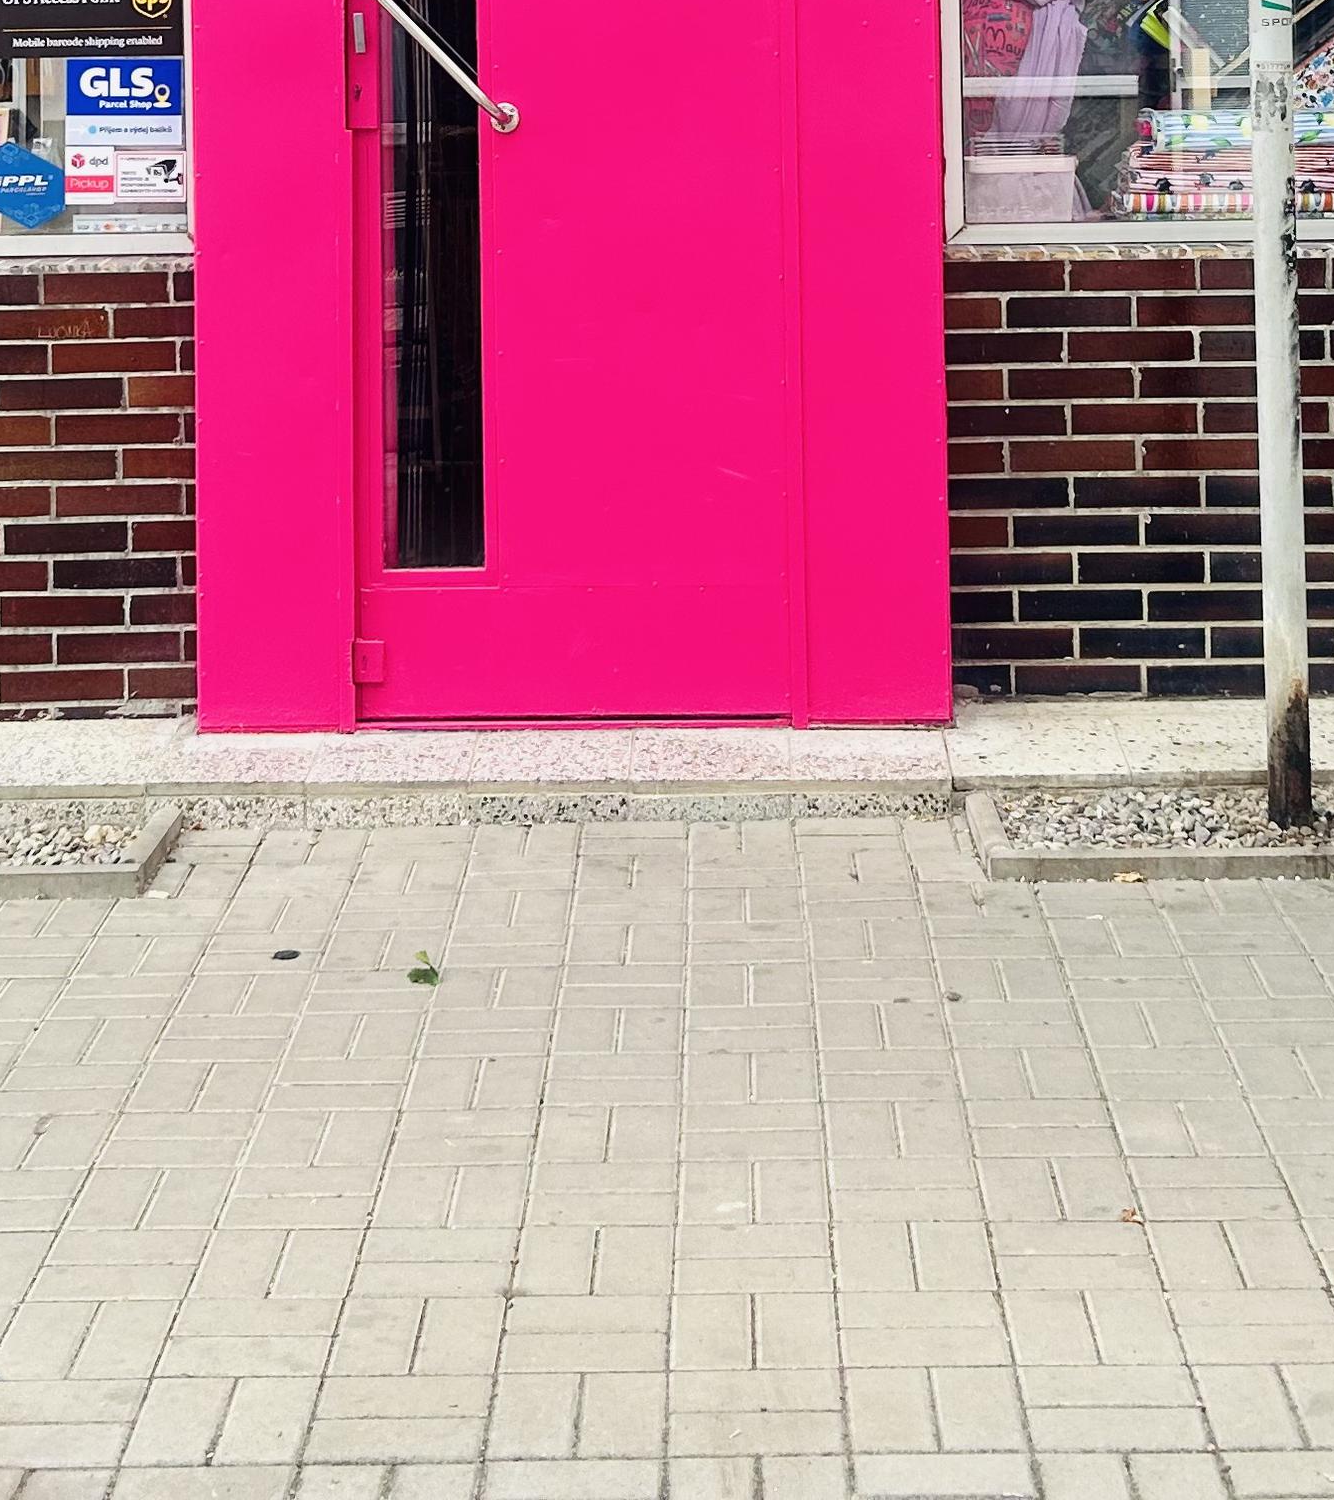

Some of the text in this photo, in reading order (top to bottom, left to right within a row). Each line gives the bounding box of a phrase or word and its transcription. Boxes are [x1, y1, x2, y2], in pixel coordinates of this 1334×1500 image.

[12, 35, 163, 49] Mobile barcode shipping enabled
[79, 67, 155, 98] GLS
[98, 100, 153, 111] Parcel Shop
[89, 156, 109, 167] dpd
[69, 178, 110, 190] Pickup
